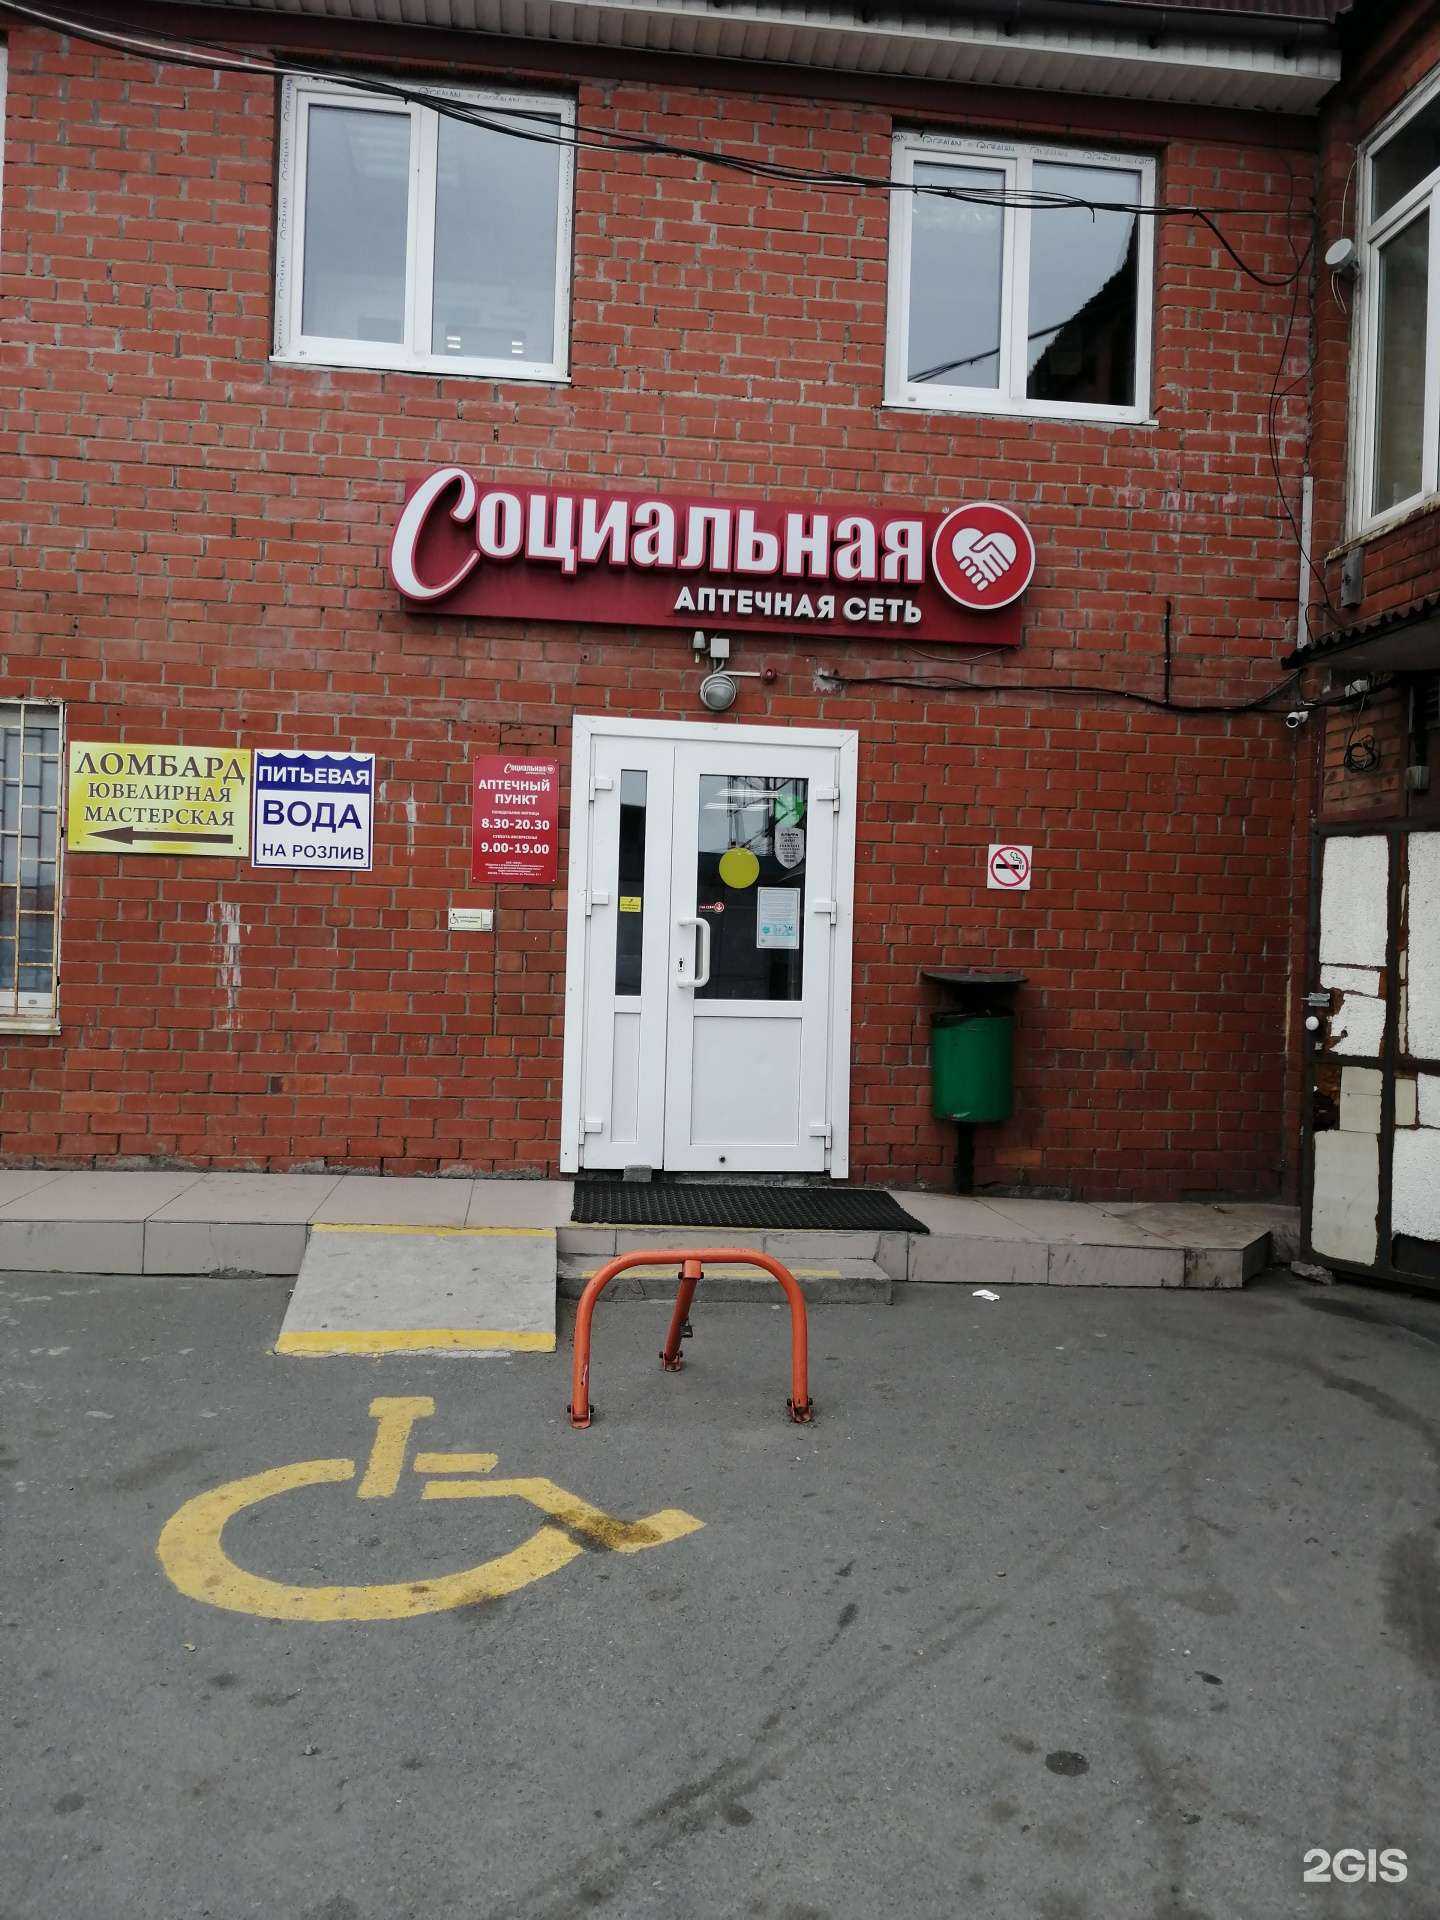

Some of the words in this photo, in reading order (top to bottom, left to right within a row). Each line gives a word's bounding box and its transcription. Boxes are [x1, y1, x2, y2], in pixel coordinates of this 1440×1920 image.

[390, 466, 925, 599] Социальная
[673, 586, 835, 619] АПТЕЧНАЯ
[843, 597, 922, 624] СЕТЬ
[74, 752, 246, 785] ЛОМБАРД
[258, 765, 370, 786] ПИТЬЕВАЯ
[88, 782, 232, 803] ЮВЕЛИРНАЯ
[478, 779, 551, 792] АПТЕЧНЫЙ
[495, 793, 539, 805] ПУНКТ
[84, 806, 235, 826] МАСТЕРСКАЯ
[262, 799, 362, 833] ВОДА
[481, 817, 550, 831] 8.30-20.30
[262, 843, 287, 857] НА
[292, 844, 365, 860] РОЗЛИВ
[480, 842, 550, 855] 9.00-19.00
